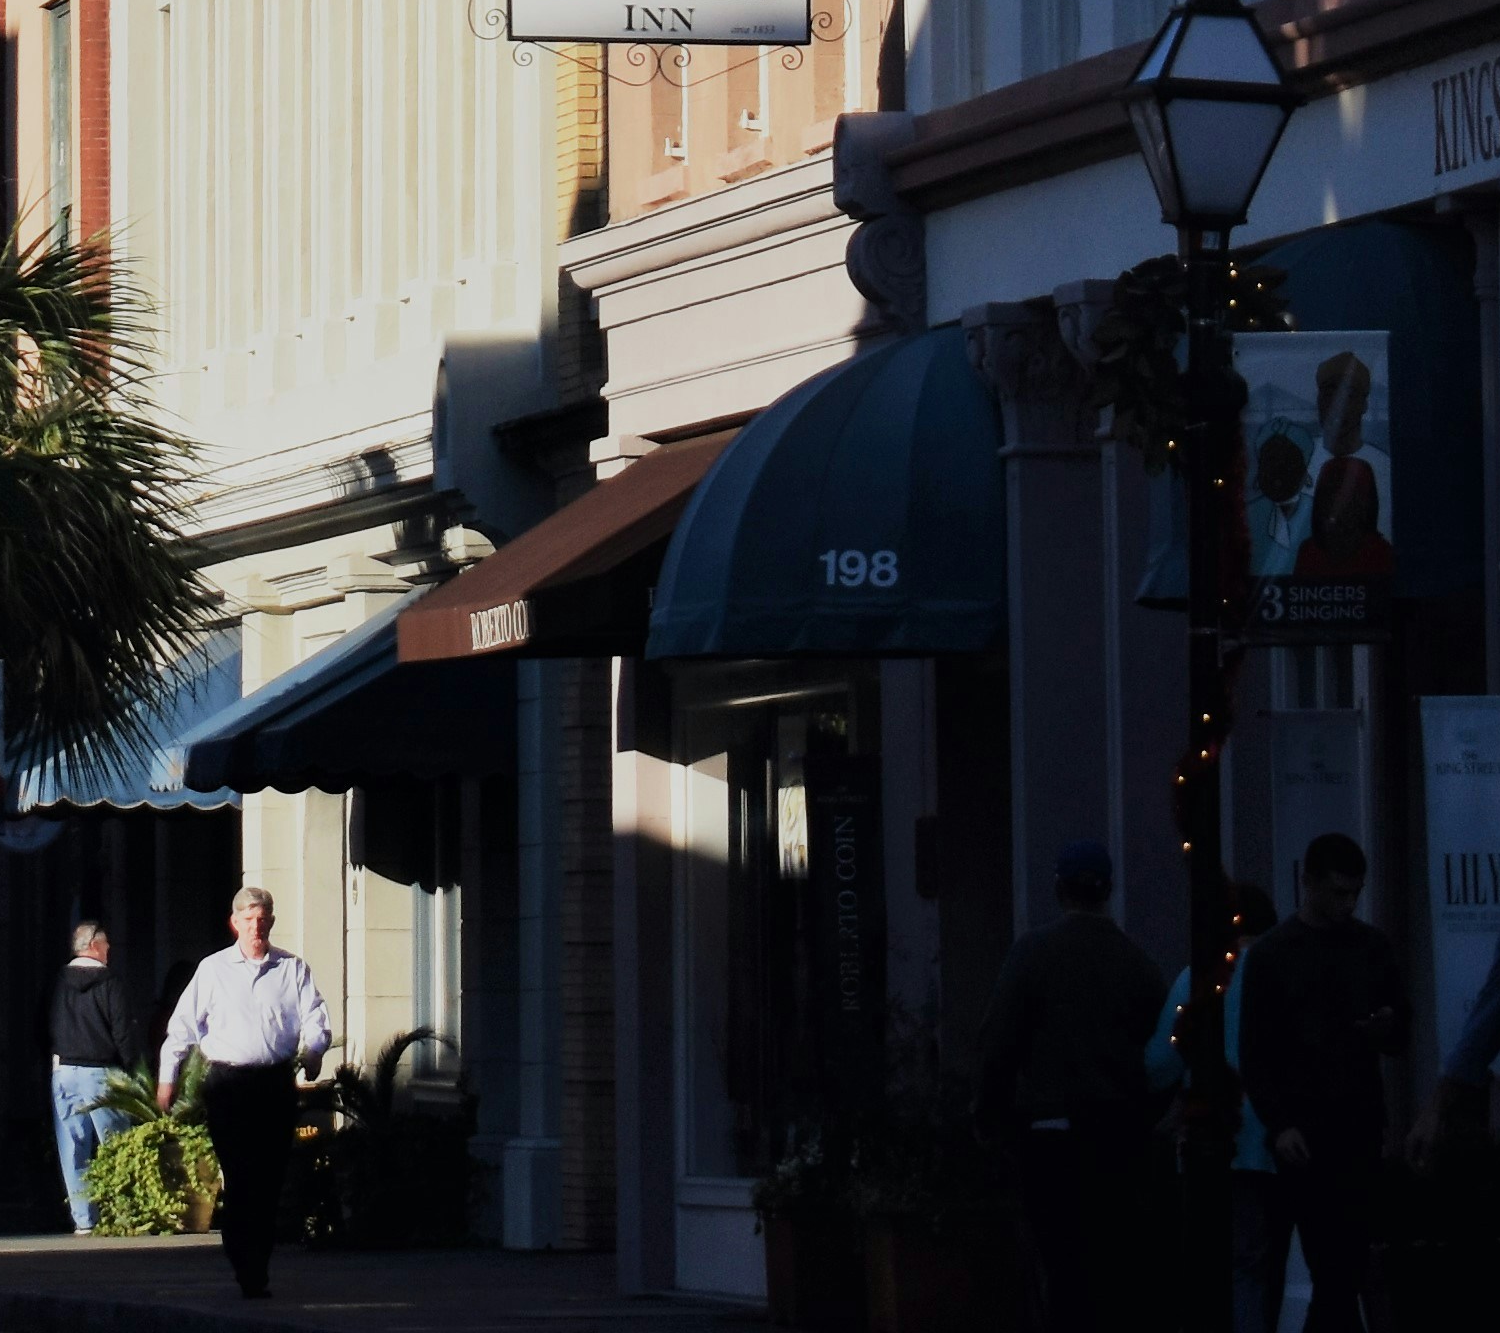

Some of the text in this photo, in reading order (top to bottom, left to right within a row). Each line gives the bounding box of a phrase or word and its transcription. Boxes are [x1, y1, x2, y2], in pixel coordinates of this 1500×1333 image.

[624, 4, 695, 32] INN
[752, 24, 776, 35] 1853
[818, 548, 899, 588] 198
[1261, 584, 1367, 622] 3 SINGERS
[1287, 604, 1367, 622] SINGING
[469, 603, 512, 651] ROBERTO
[834, 815, 856, 881] COIN
